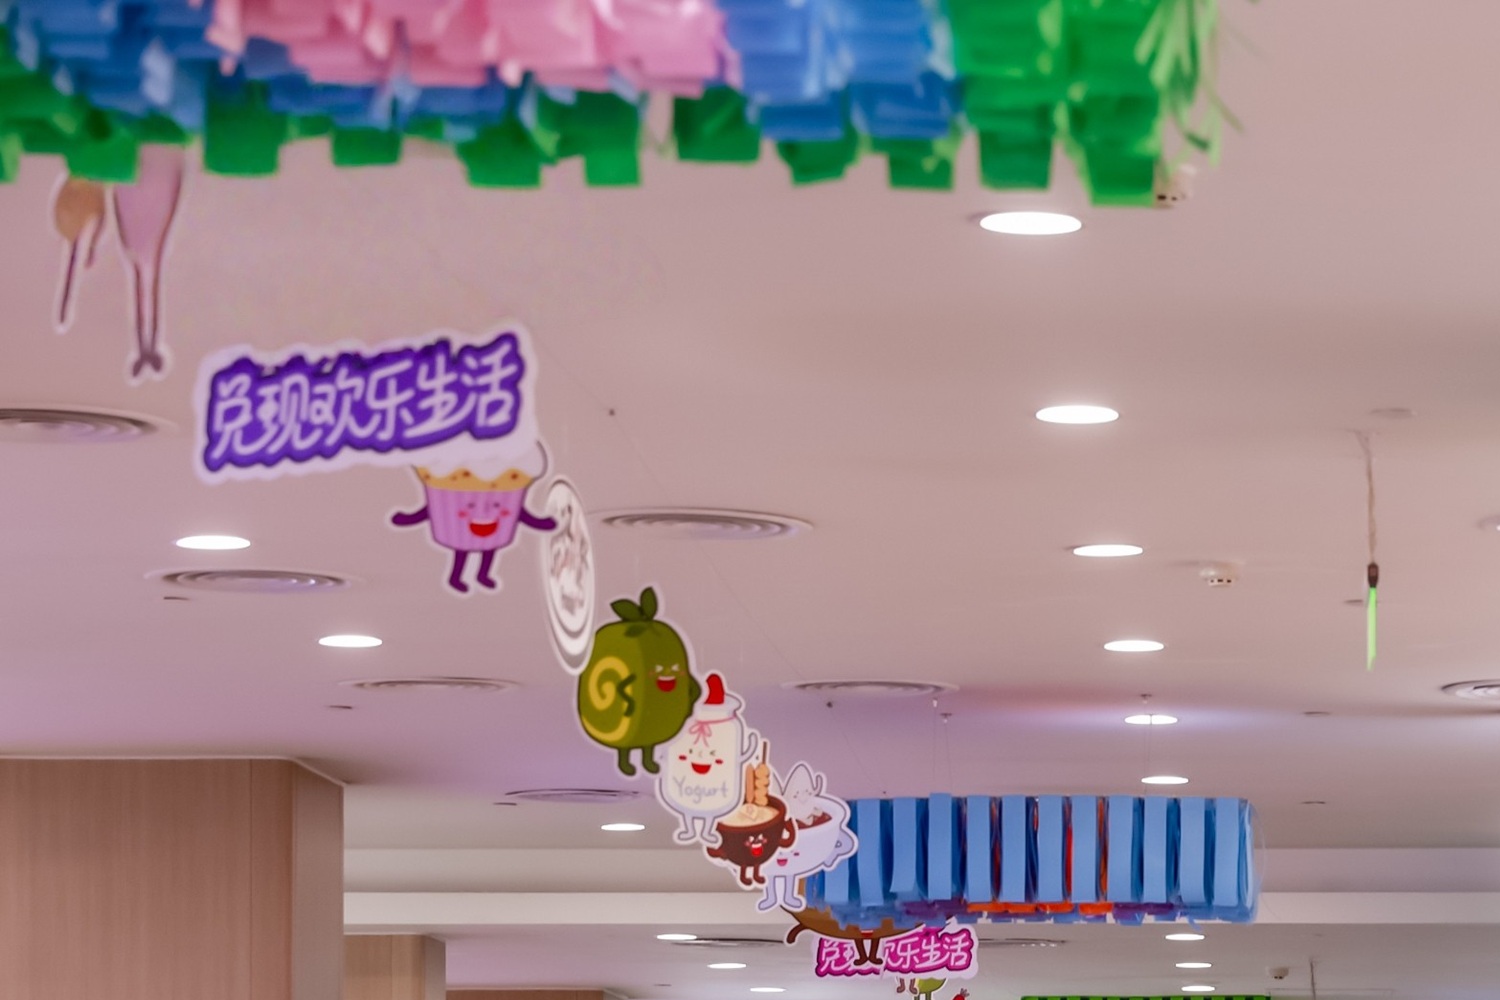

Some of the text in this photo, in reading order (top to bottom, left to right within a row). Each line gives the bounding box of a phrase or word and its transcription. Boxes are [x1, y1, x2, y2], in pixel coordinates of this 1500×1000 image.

[209, 341, 518, 459] 兑现欢乐生活
[671, 775, 729, 804] Yogurt
